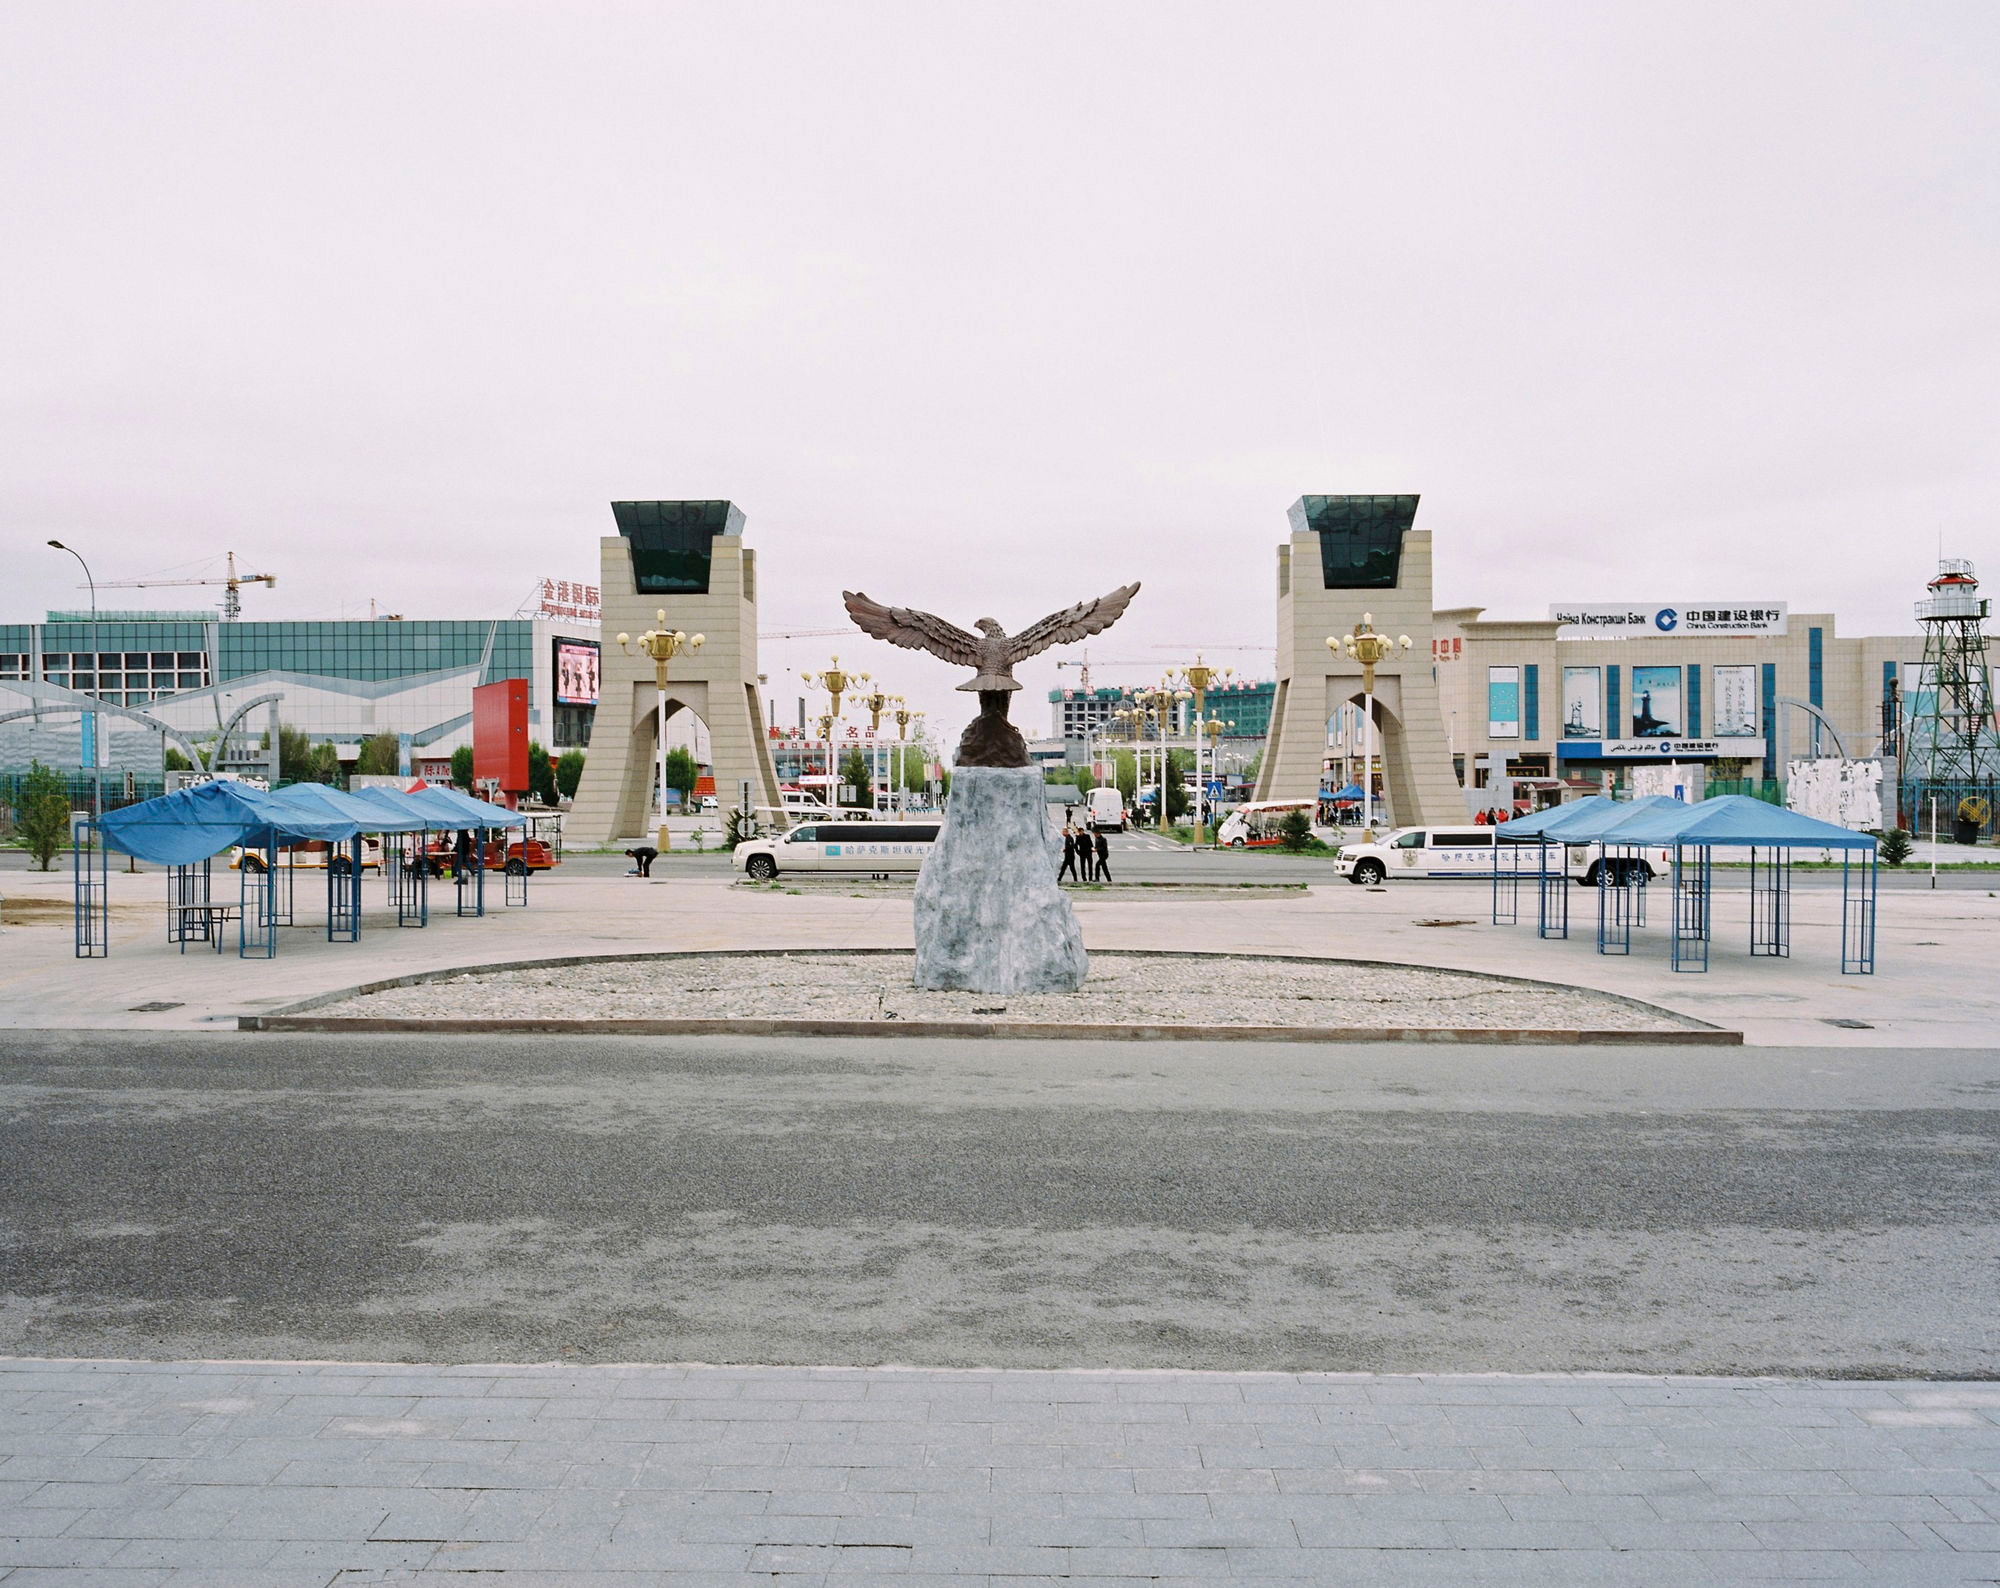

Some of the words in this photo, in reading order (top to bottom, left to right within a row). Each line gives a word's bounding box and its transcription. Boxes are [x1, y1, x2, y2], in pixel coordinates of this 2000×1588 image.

[1581, 612, 1627, 628] Констракшн
[1628, 612, 1647, 625] Банк
[1686, 609, 1780, 622] 中国建设银行
[1686, 622, 1706, 630] China
